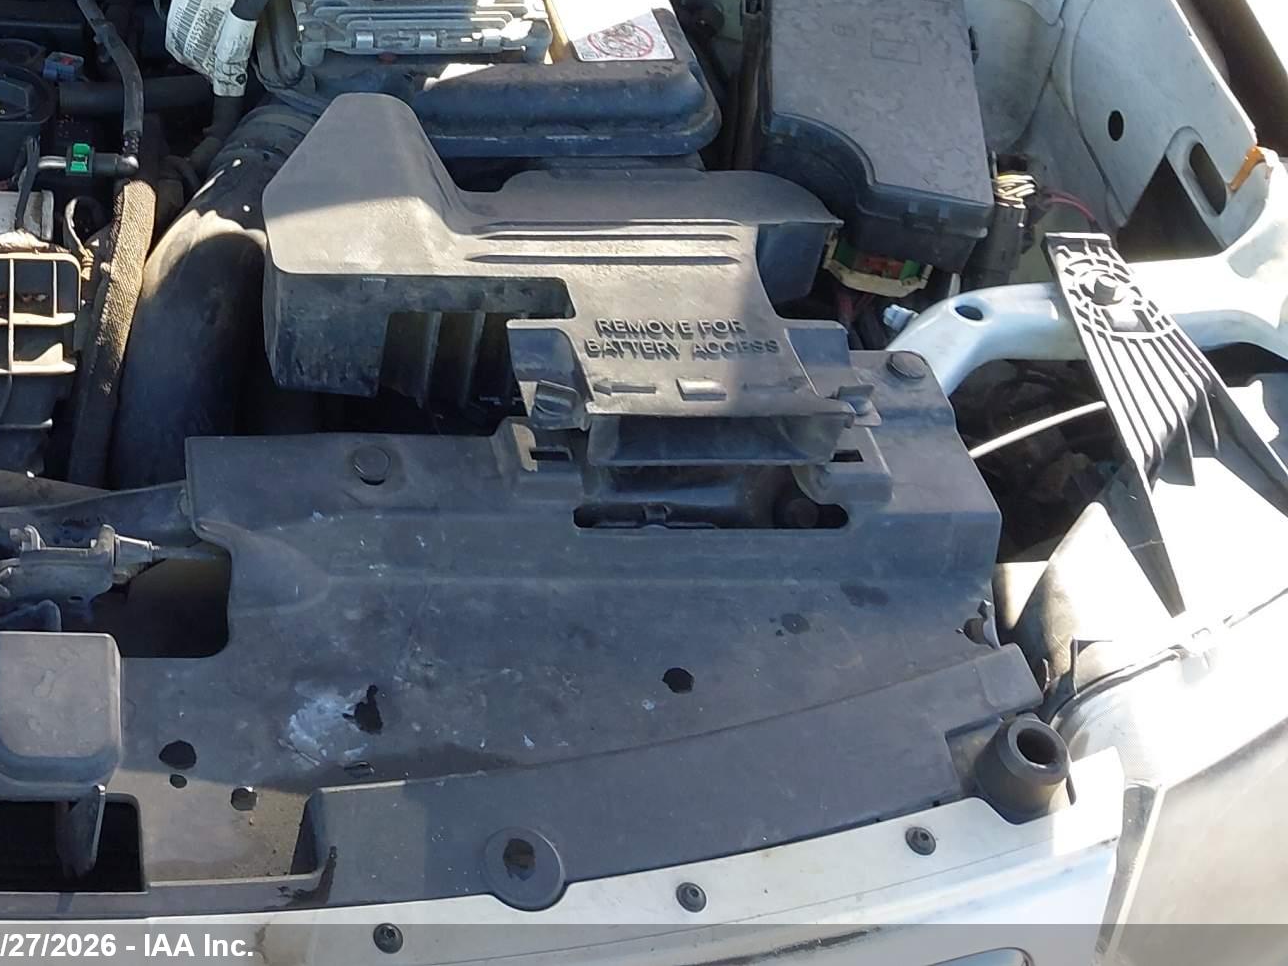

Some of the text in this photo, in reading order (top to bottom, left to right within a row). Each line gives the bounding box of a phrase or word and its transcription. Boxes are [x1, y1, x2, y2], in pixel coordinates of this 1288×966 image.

[596, 318, 745, 338] REMOVE FOR
[584, 338, 779, 360] BATTERY ACCESS
